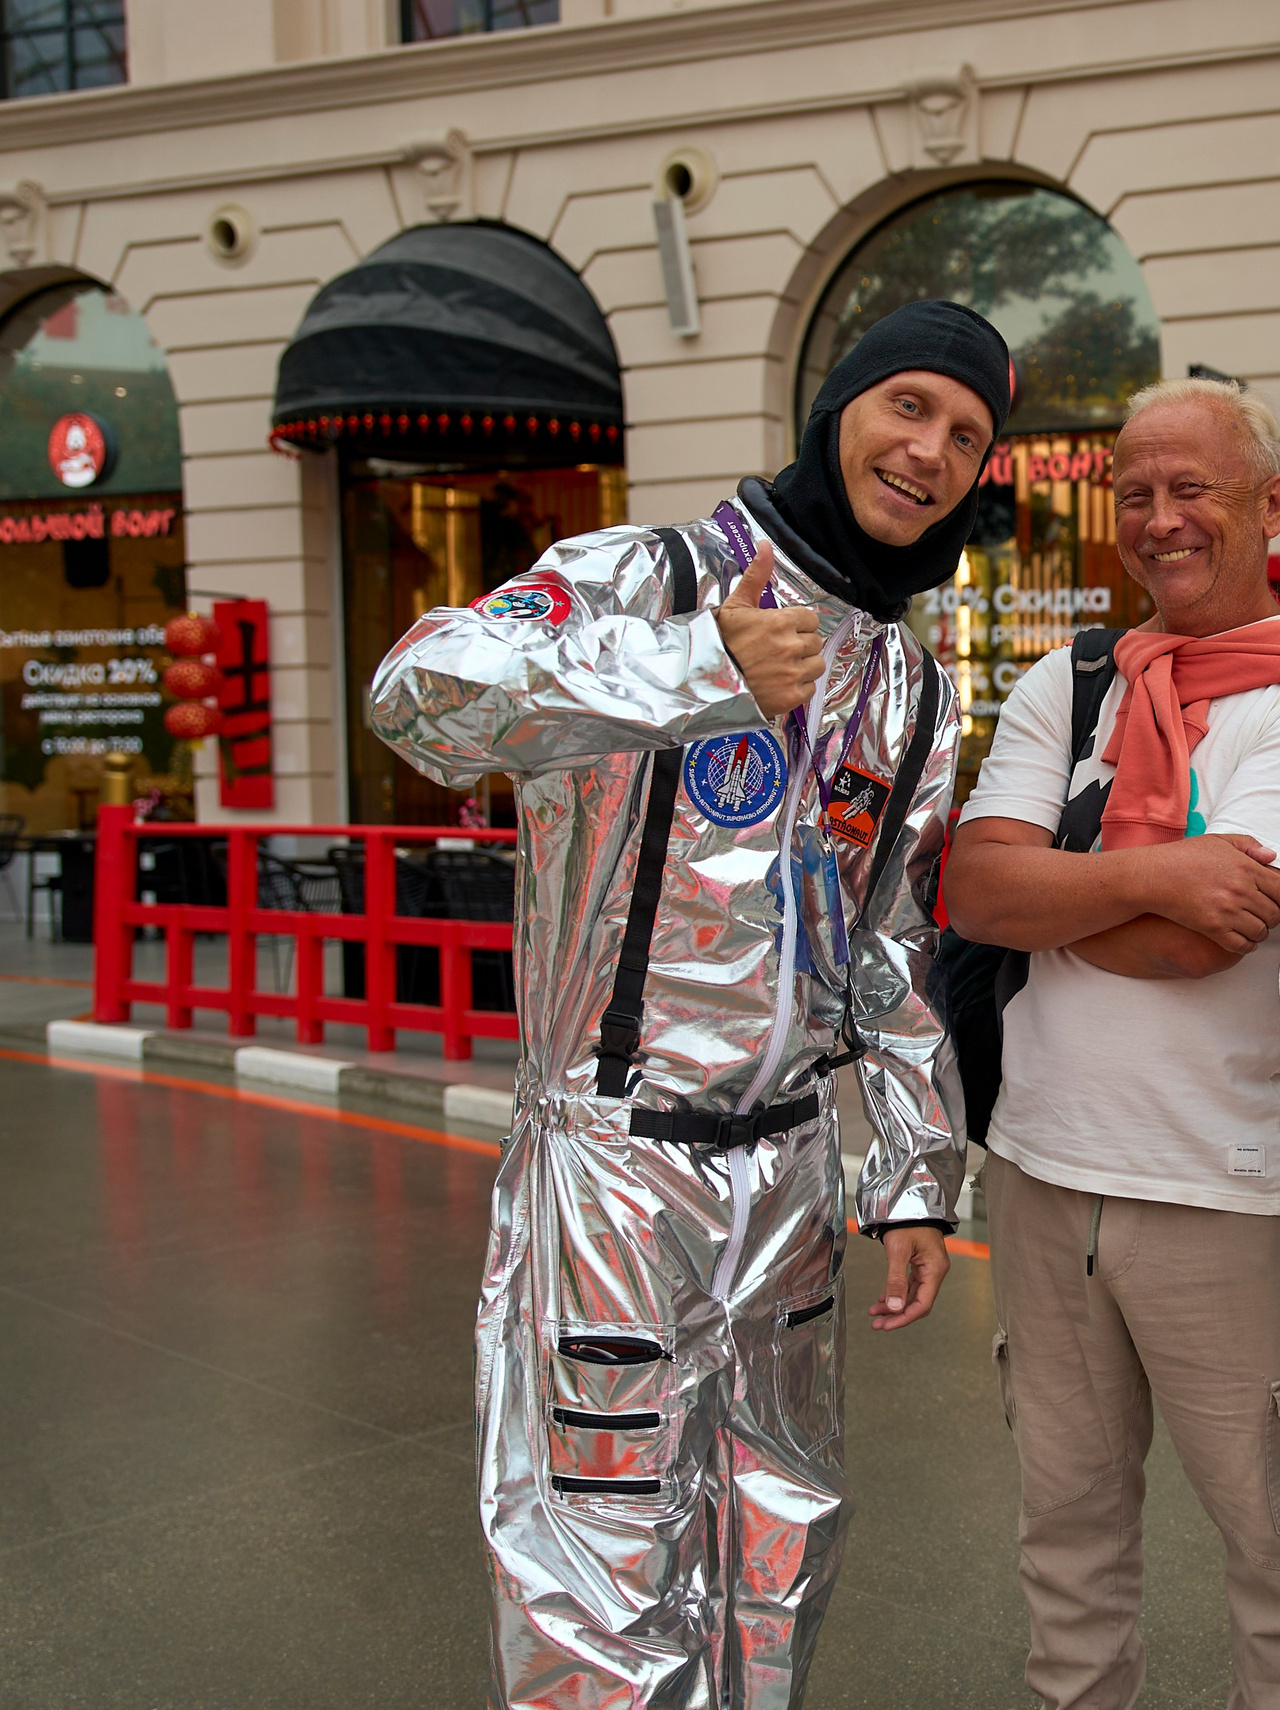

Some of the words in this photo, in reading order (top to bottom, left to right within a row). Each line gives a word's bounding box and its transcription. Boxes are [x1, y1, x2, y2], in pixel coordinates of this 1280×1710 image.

[0, 502, 104, 544] ОЛЬШОЙ
[727, 521, 753, 566] ехпросвет
[992, 583, 1111, 618] Скидка
[136, 623, 166, 646] обе
[23, 660, 105, 687] Скидка
[107, 659, 158, 684] 20%
[692, 738, 710, 760] SUPERH
[829, 816, 868, 841] ASTRONAUT
